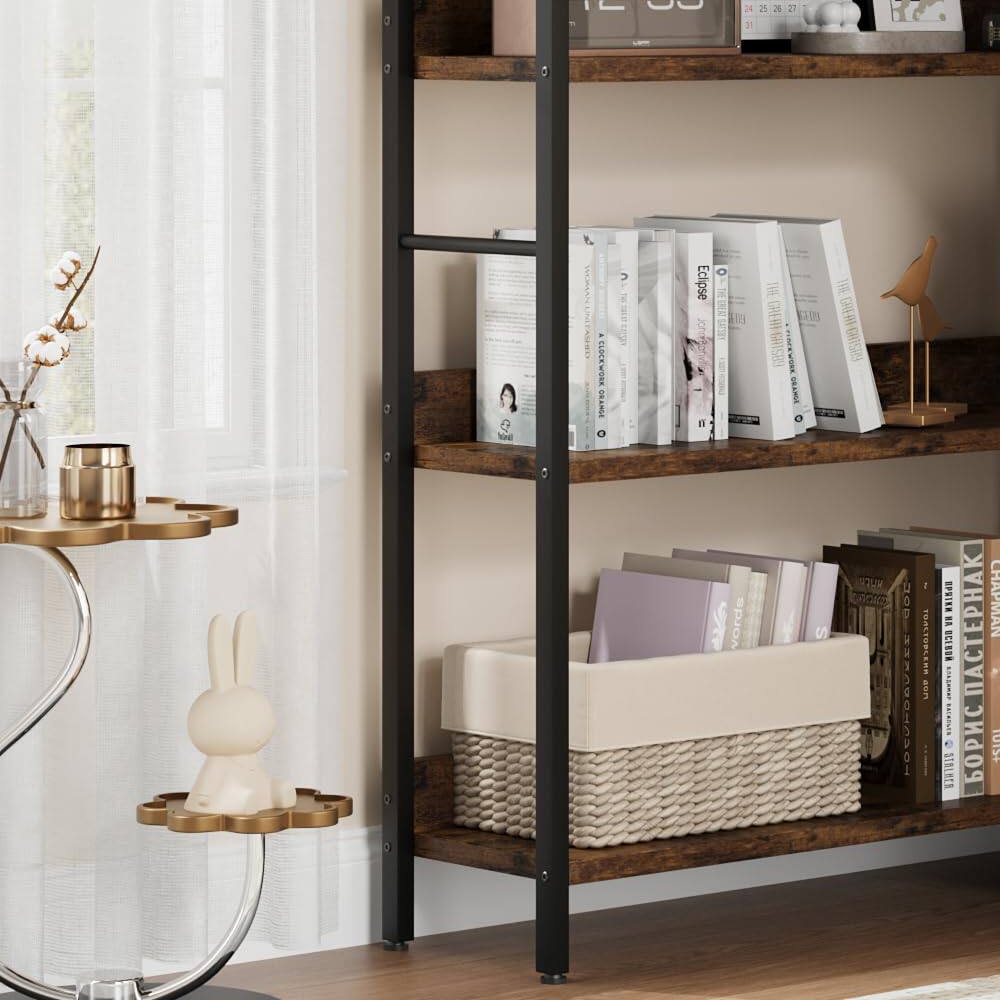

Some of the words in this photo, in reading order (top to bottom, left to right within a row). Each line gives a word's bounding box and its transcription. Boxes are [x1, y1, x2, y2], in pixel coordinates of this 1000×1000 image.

[744, 5, 753, 14] 24
[759, 5, 768, 14] 25
[773, 5, 782, 14] 26
[787, 5, 797, 14] 27
[744, 21, 753, 30] 31
[583, 264, 592, 304] WOMAN
[695, 264, 710, 301] Eclipse
[717, 287, 727, 298] THE
[717, 299, 727, 318] GREAT
[717, 318, 727, 341] GATSBY
[597, 340, 606, 387] CLOCKWORK
[785, 329, 796, 374] CLOCKWORK
[597, 389, 606, 419] ORANGE
[789, 376, 801, 406] ORANGE
[944, 580, 954, 613] ПРЯТКИ
[944, 615, 954, 628] НА
[963, 552, 984, 702] ПАСТЕРНАК
[944, 629, 955, 662] ОСЕВОЙ
[963, 704, 984, 784] БОРИС
